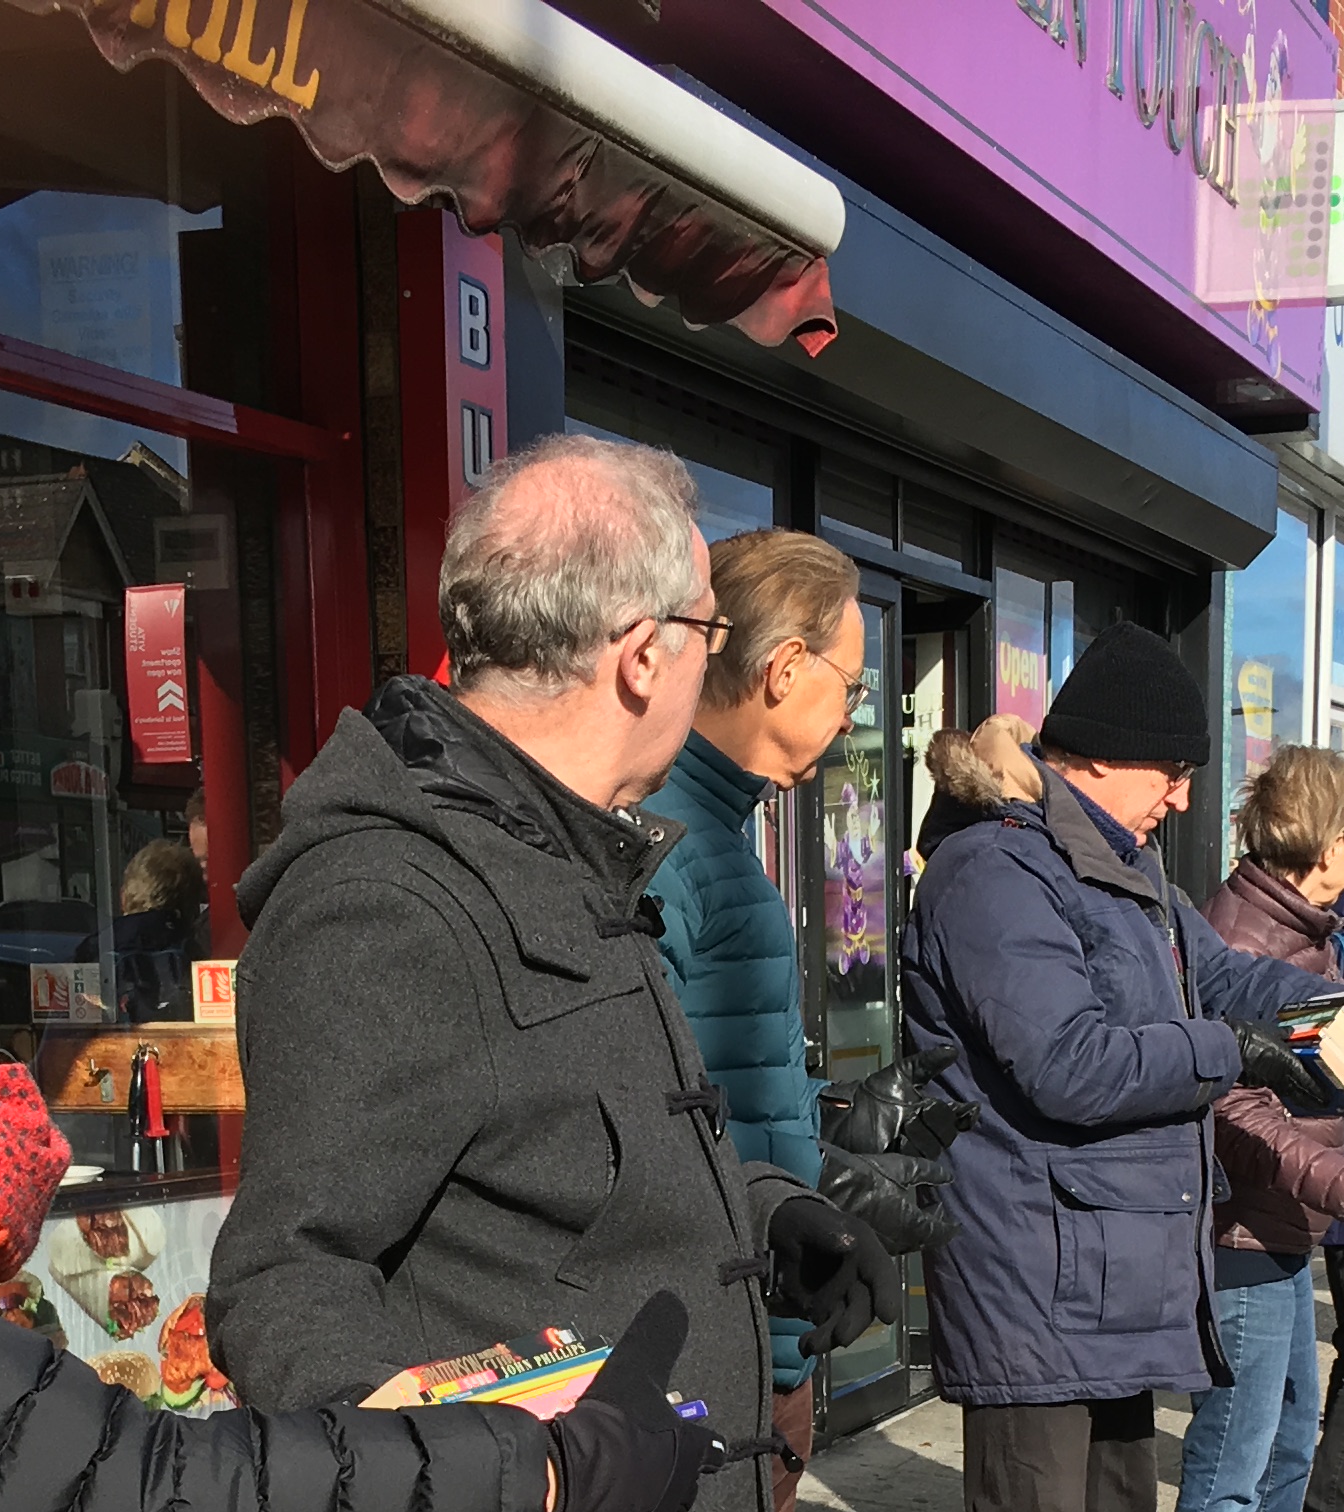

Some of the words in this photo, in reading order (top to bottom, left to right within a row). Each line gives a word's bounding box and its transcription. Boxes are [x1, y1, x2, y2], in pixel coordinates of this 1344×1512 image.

[999, 631, 1039, 698] Open
[501, 1358, 534, 1379] JOHN
[533, 1341, 587, 1368] PHILLIPS
